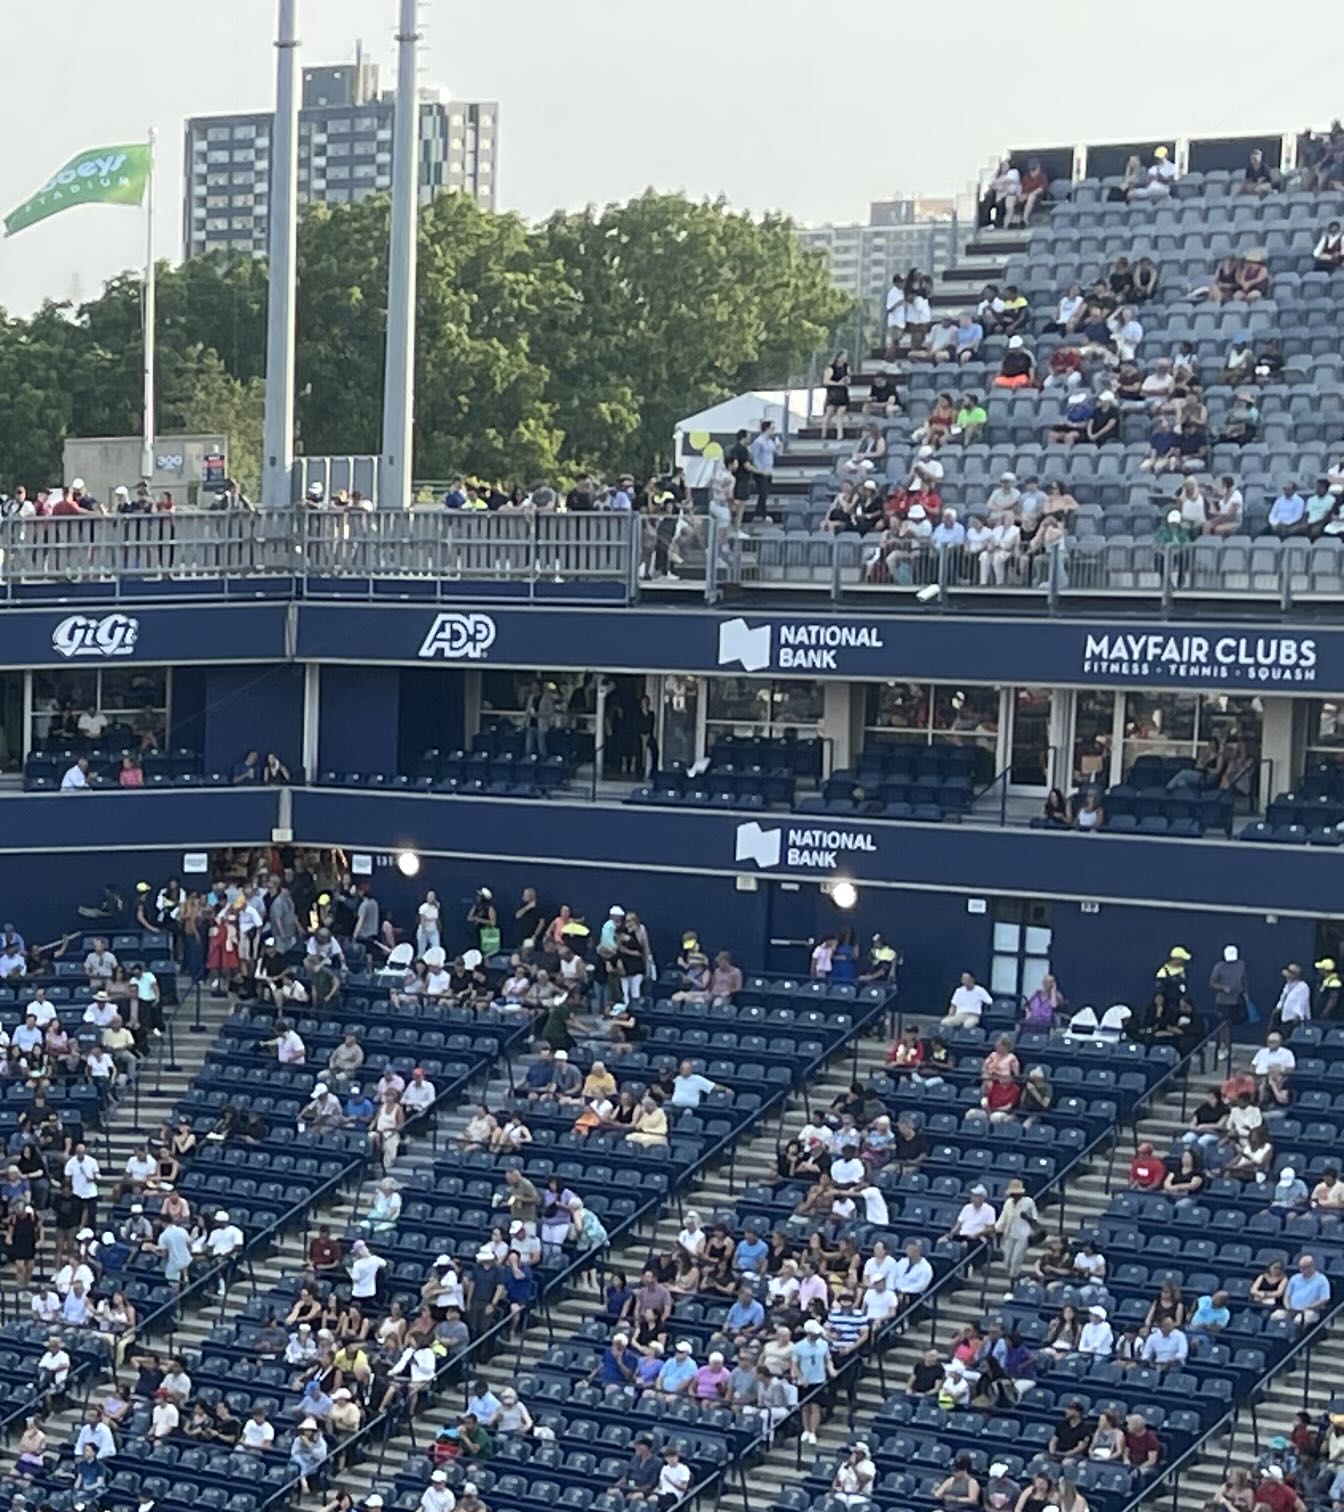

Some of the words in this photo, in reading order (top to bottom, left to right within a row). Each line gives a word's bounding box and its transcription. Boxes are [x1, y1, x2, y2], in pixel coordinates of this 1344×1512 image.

[52, 614, 138, 656] GiGi
[419, 613, 496, 657] ADP
[779, 625, 883, 648] NATIONAL
[779, 647, 837, 669] BANK
[1084, 633, 1209, 664] MAYFAIR
[1215, 637, 1316, 667] CLUBS
[1084, 661, 1149, 676] FITNESS
[1169, 663, 1229, 679] TENNIS
[1247, 665, 1316, 681] SQUASH
[788, 829, 876, 851] NATIONAL
[787, 848, 837, 869] BANK
